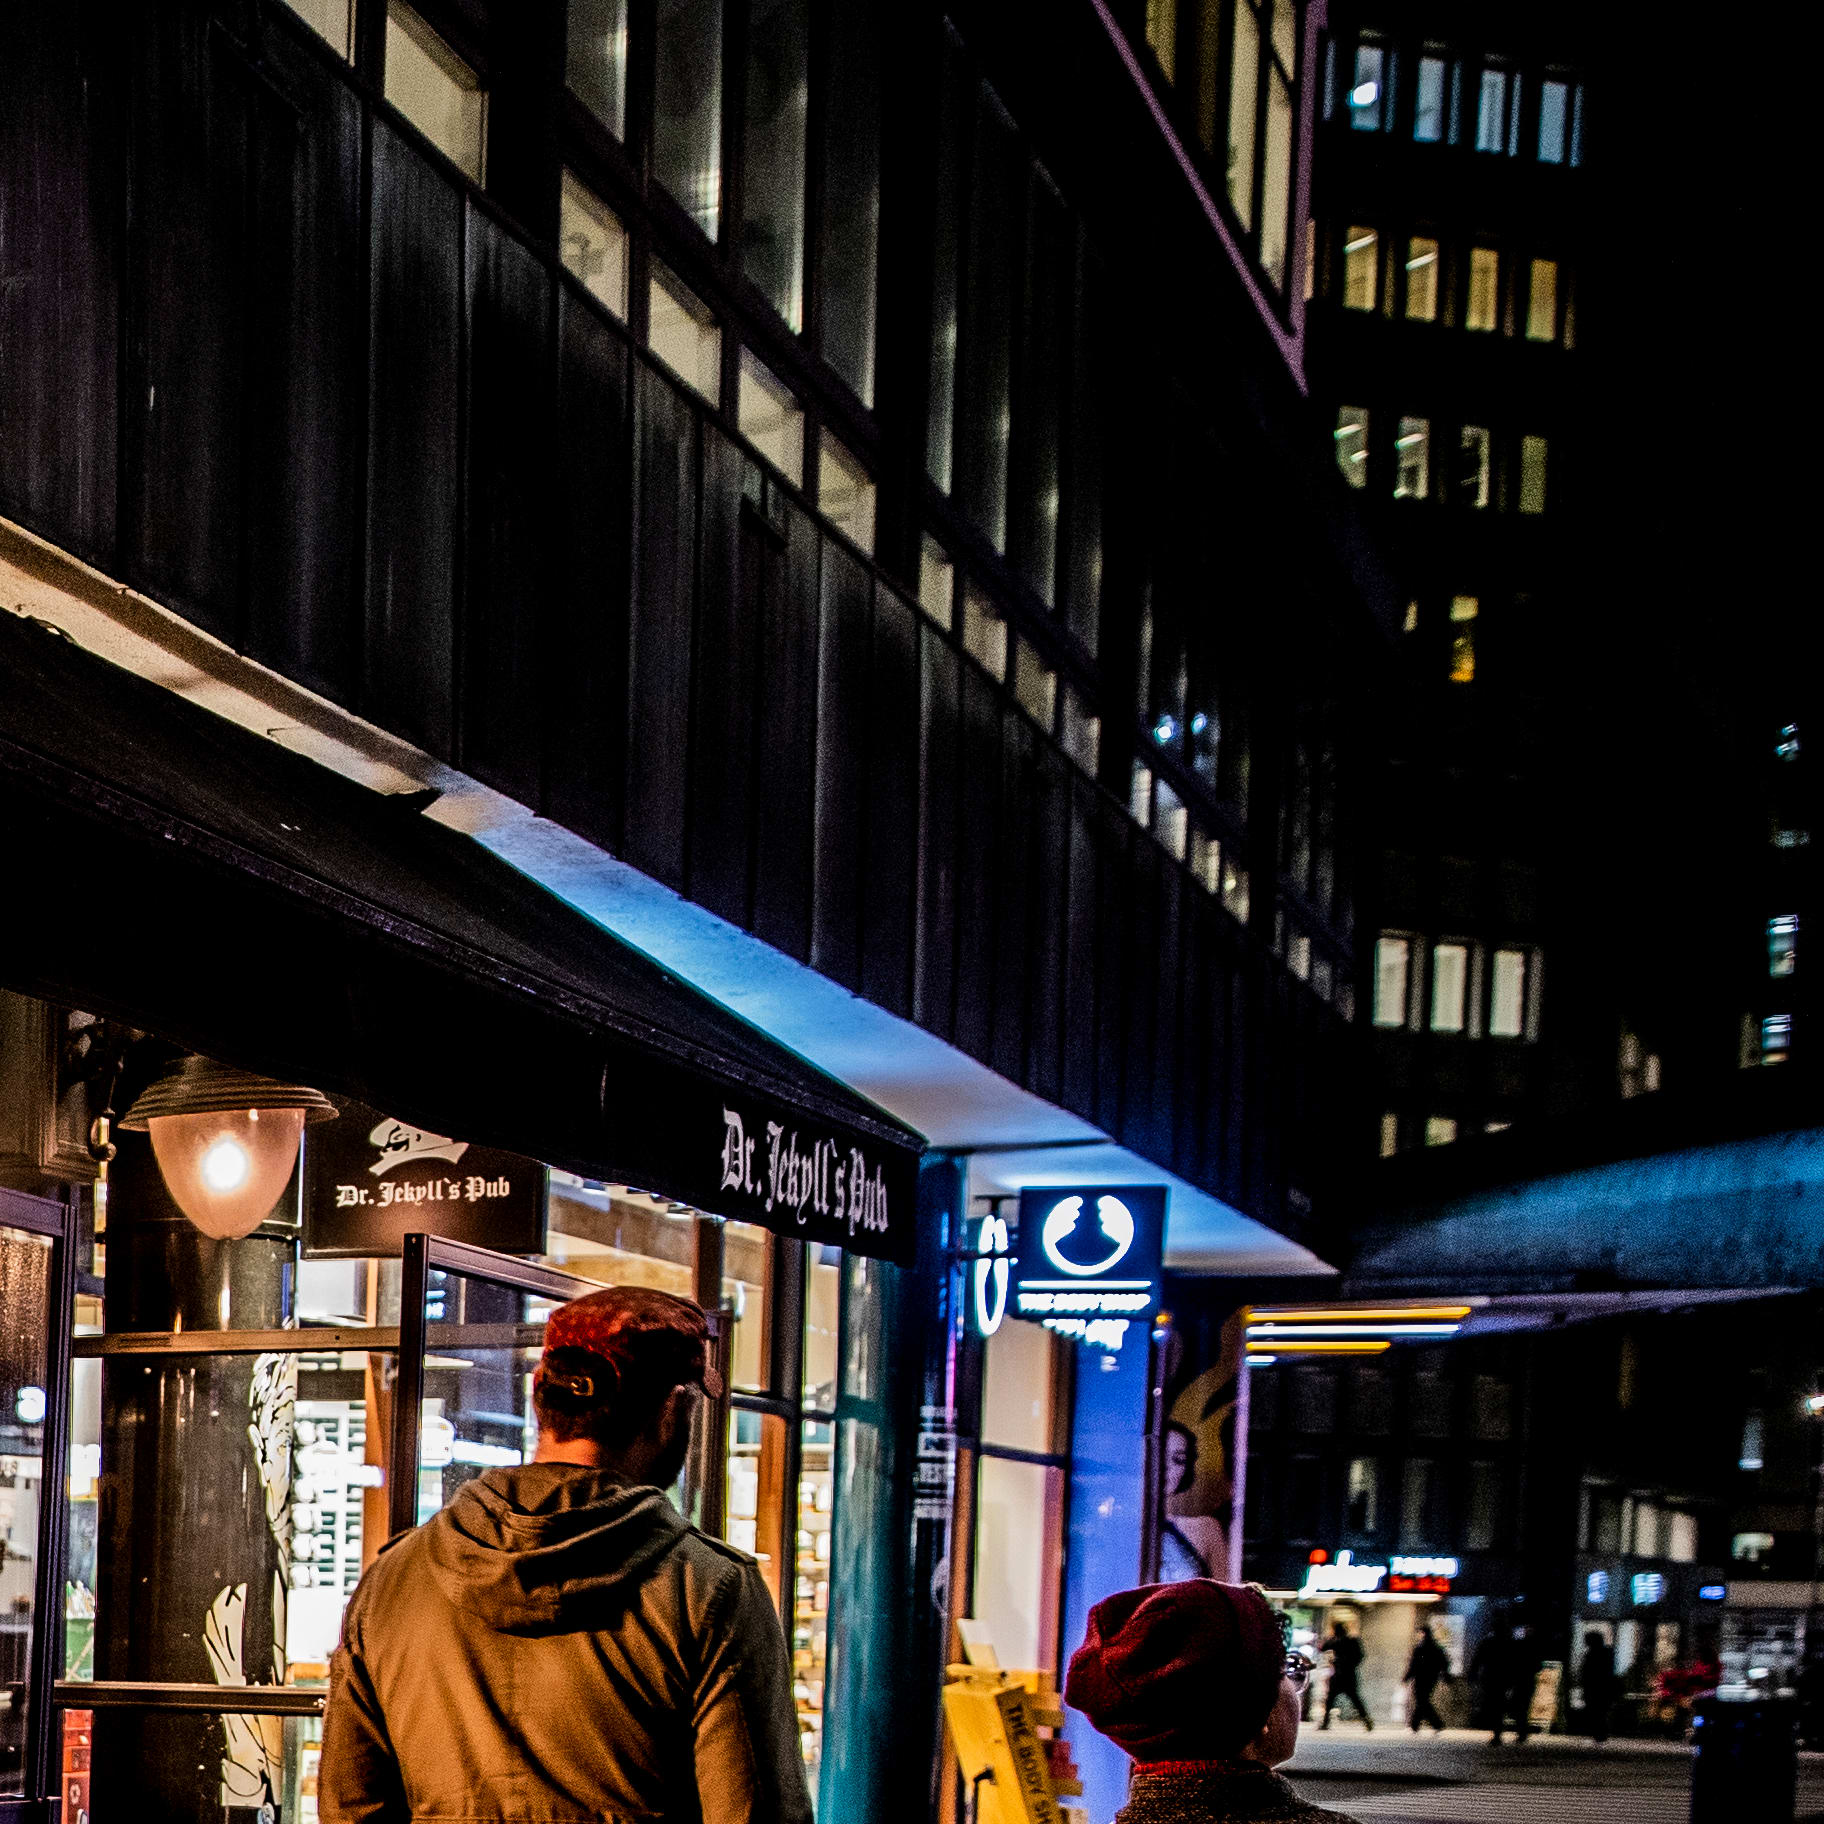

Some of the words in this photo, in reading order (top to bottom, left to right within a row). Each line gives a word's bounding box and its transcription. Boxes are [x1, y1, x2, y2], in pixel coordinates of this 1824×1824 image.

[336, 1185, 375, 1208] Dr.
[464, 1175, 510, 1202] Pub
[720, 1102, 762, 1196] Dr.
[848, 1147, 889, 1236] Pub
